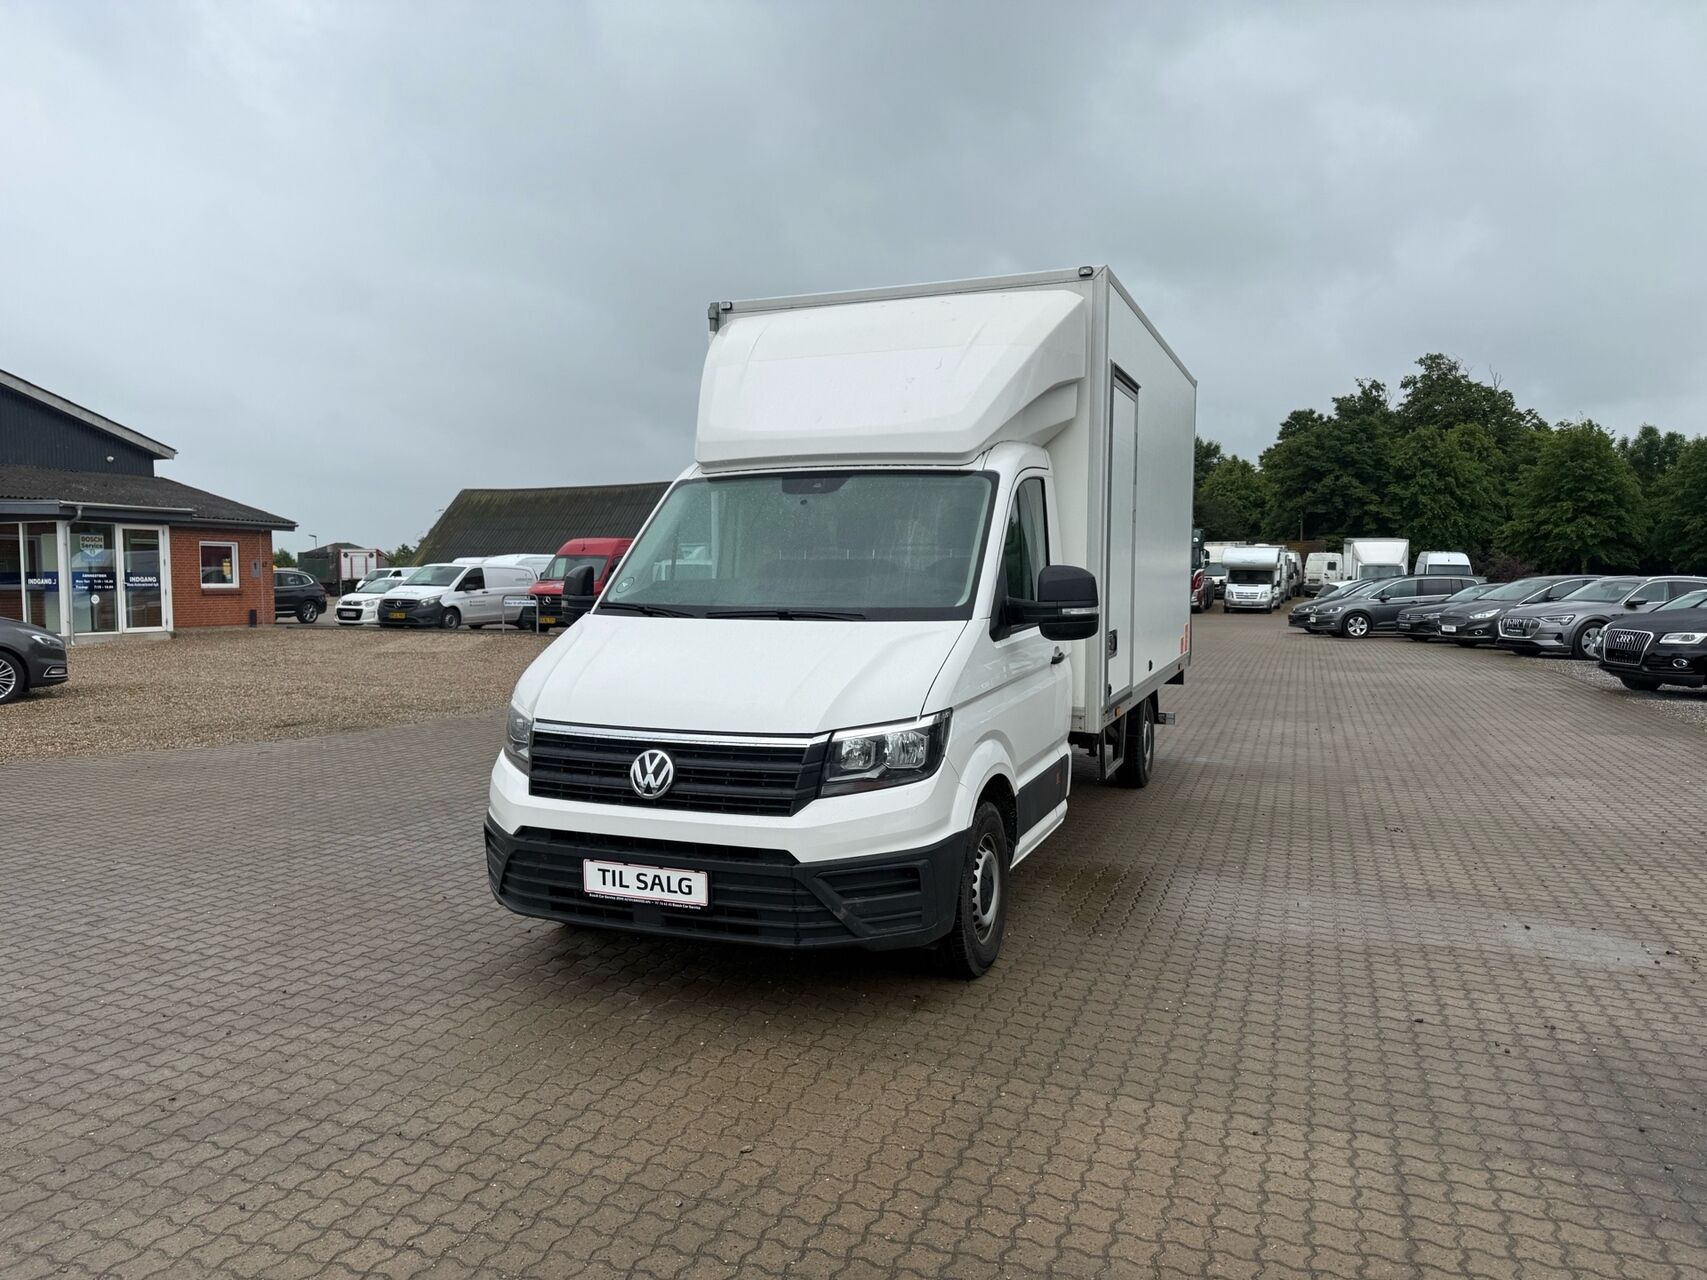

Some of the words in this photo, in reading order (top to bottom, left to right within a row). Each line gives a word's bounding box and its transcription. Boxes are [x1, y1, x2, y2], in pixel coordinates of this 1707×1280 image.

[630, 749, 674, 799] VW
[597, 867, 630, 889] TIL
[636, 872, 693, 896] SALG
